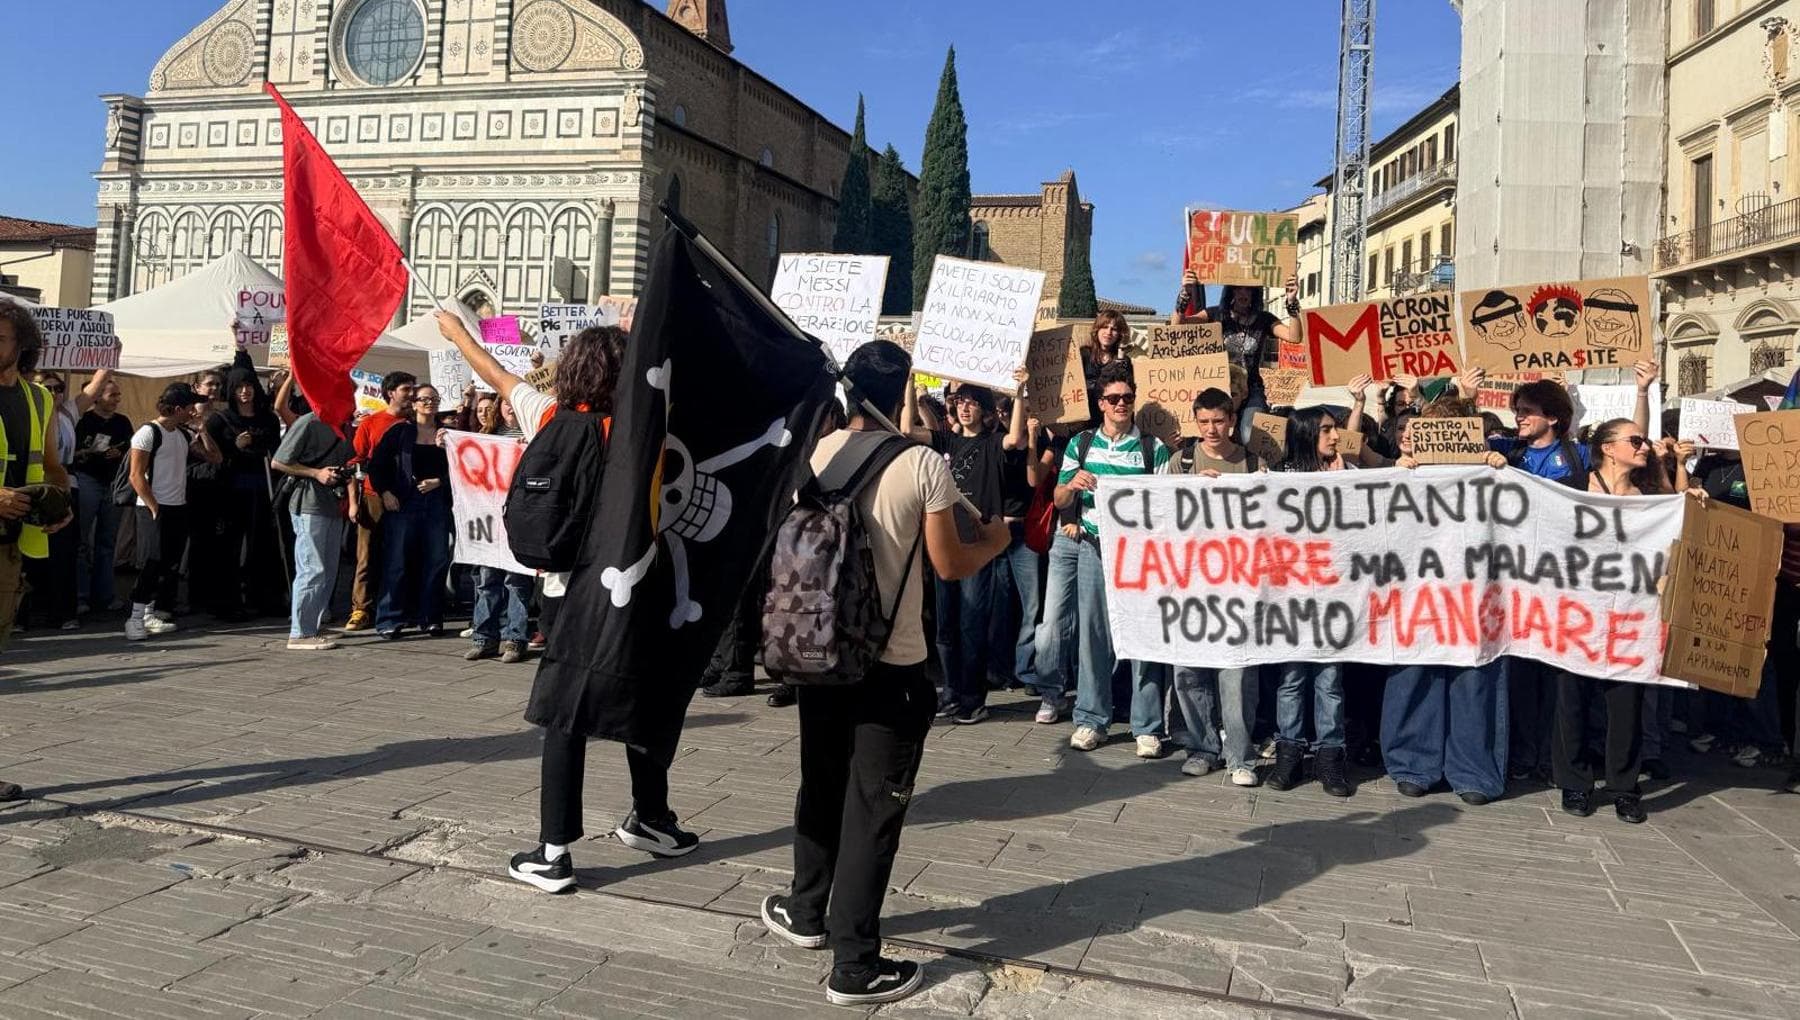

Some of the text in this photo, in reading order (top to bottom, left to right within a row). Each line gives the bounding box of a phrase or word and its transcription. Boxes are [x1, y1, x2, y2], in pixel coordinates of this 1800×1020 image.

[1193, 211, 1297, 246] SCUOLA
[782, 257, 863, 275] VI SIETE
[798, 275, 851, 293] MESSI
[936, 262, 978, 282] AVETE
[988, 273, 1036, 296] SOLDI
[776, 291, 873, 314] CONTRO LA
[963, 286, 1018, 311] RIARMO
[67, 309, 93, 321] PURE
[541, 305, 604, 319] BETTER A
[928, 302, 947, 317] MA
[951, 305, 980, 321] NON
[998, 317, 1017, 329] LA
[57, 333, 71, 347] LO
[76, 334, 114, 348] STESSO
[540, 336, 551, 348] A
[1153, 326, 1213, 346] Rigurgito
[1394, 332, 1454, 352] STESSA
[919, 342, 1017, 375] VERGOGNA
[1513, 349, 1619, 370] PARA$ITE
[1148, 365, 1226, 385] FONDI ALLE
[1412, 421, 1480, 430] CONTRO IL
[1412, 431, 1470, 443] SISTEMA
[1414, 442, 1485, 454] AUTORITARIO
[1752, 452, 1780, 471] LA
[1752, 477, 1774, 491] LA
[1108, 477, 1627, 543] CI DITE SOLTANTO DI
[467, 513, 495, 544] IN
[1705, 524, 1740, 551] UNA
[1113, 536, 1665, 595] LAVORARE MA A MALAPEN
[1686, 547, 1740, 584] MALATTIA
[1692, 576, 1749, 605] MORTALE
[1157, 594, 1355, 650] POSSIAMO
[1690, 601, 1767, 632] NON ASPETTA
